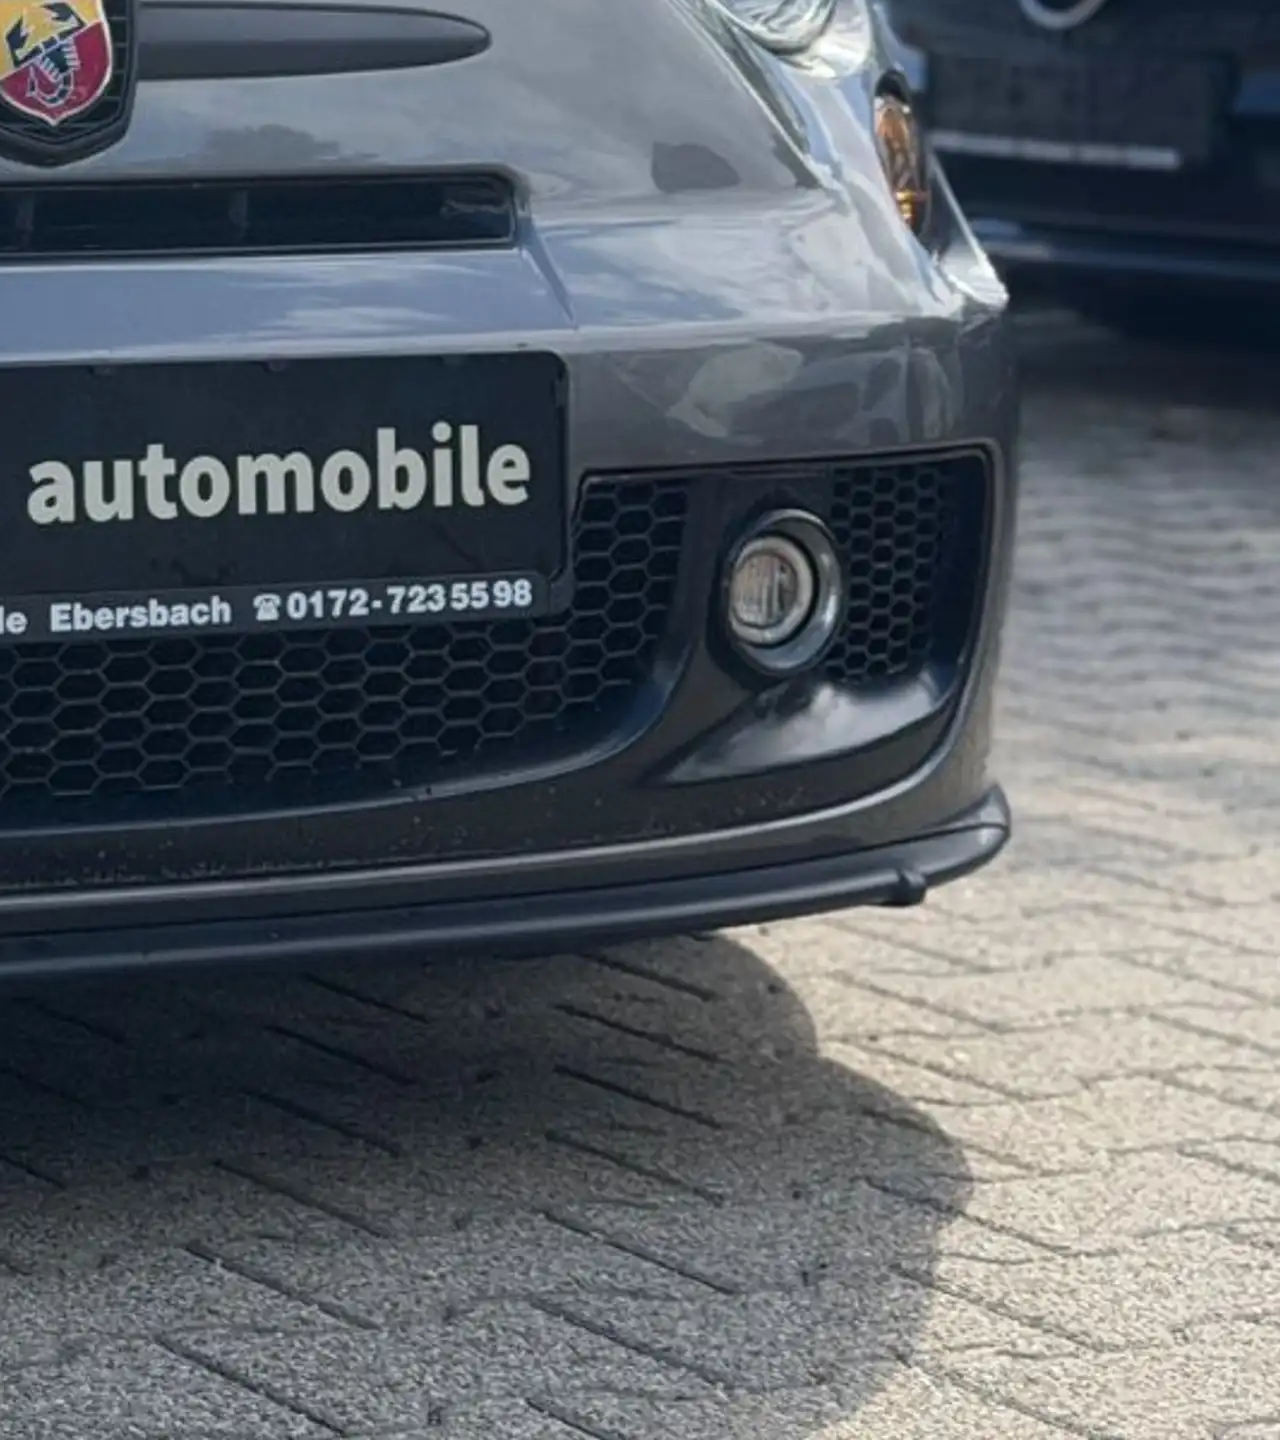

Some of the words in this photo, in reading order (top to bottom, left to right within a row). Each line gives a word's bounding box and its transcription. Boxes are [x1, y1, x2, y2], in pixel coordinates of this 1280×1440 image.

[26, 420, 532, 526] automobile
[49, 594, 233, 634] Ebersbach
[285, 577, 534, 621] 0172-7235598
